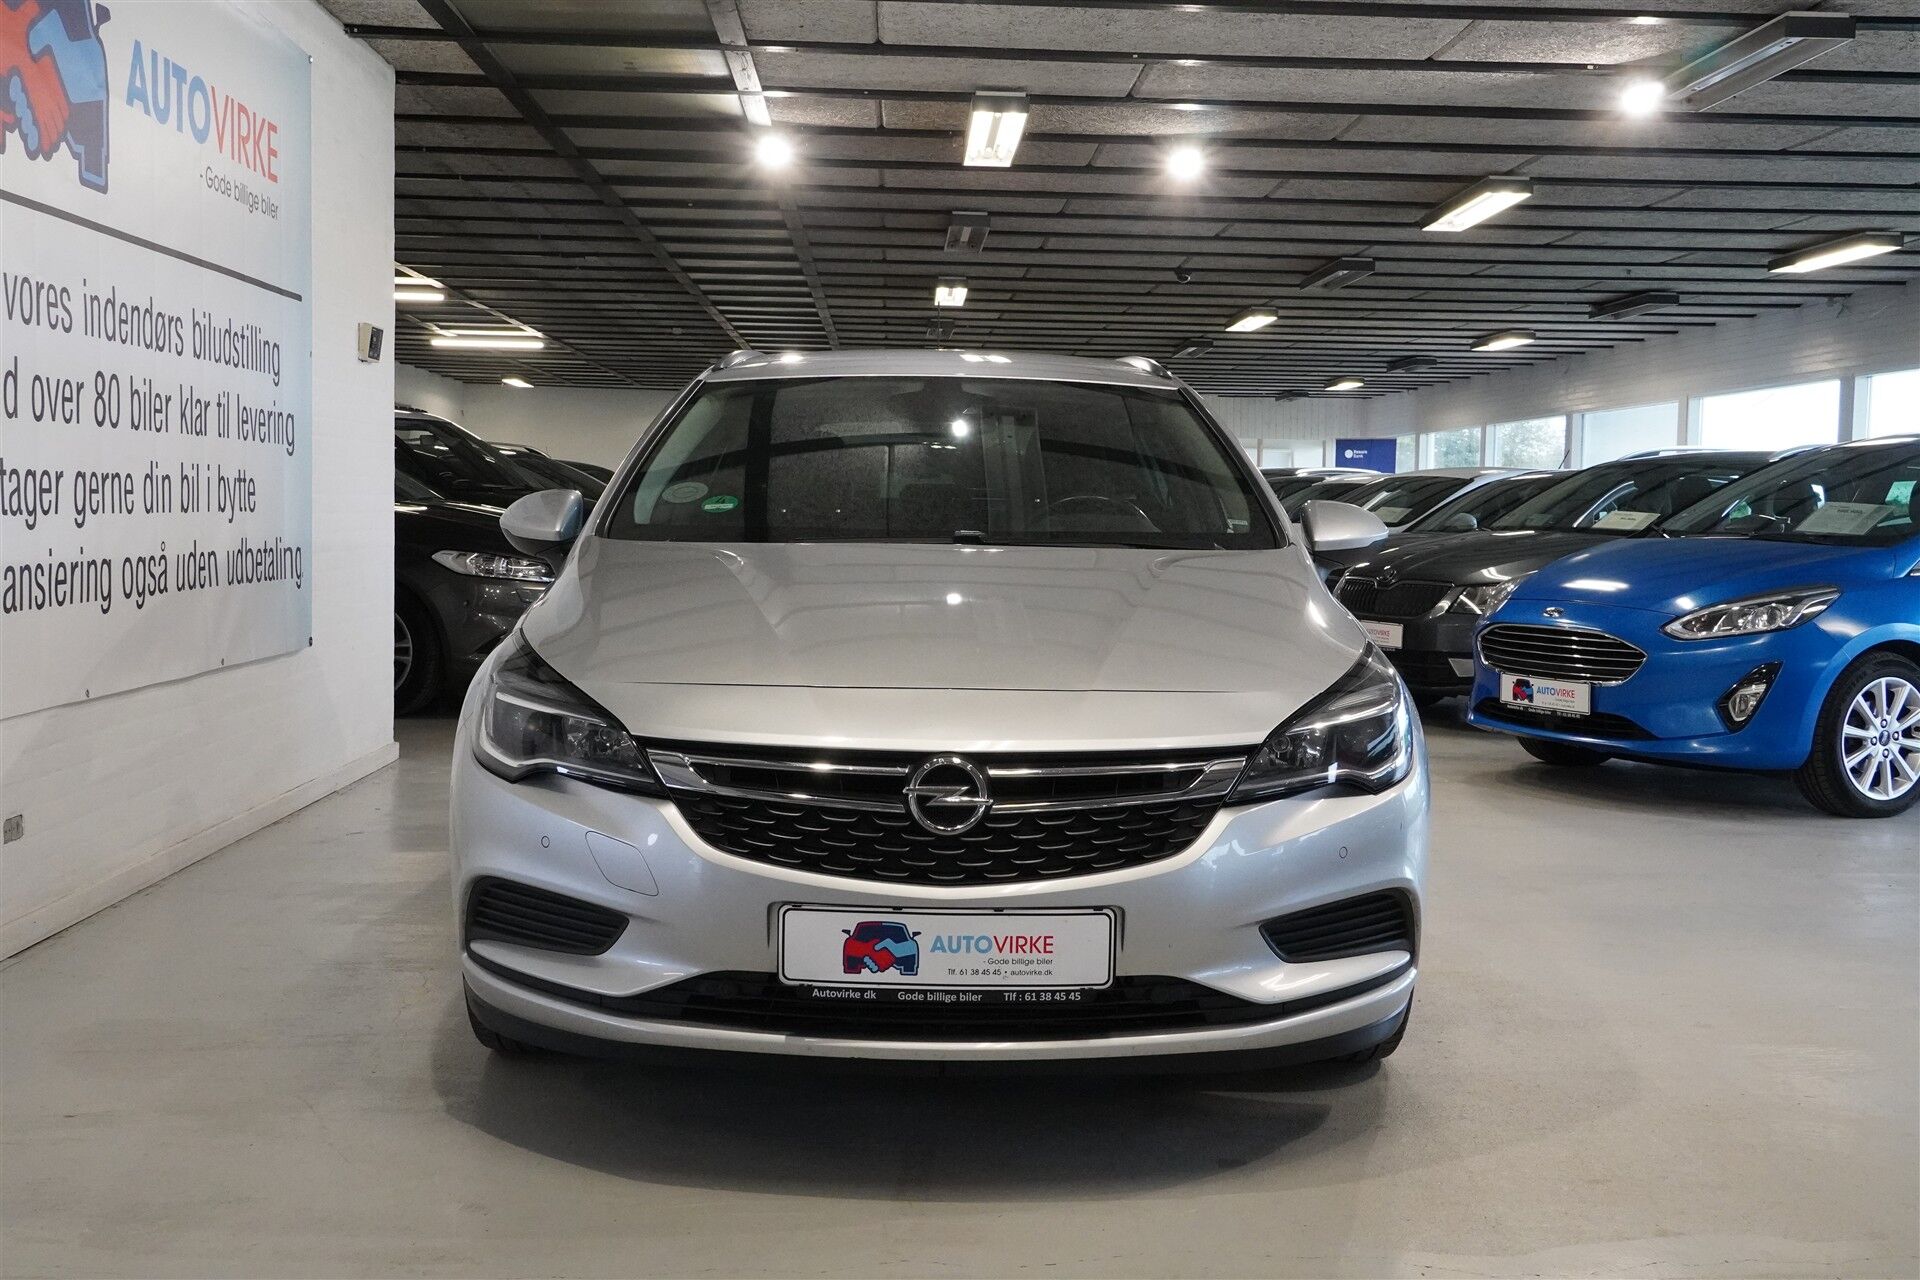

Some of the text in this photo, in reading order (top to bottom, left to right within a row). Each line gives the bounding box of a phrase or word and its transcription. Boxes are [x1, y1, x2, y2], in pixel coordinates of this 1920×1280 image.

[125, 39, 279, 184] AUTOVIRKE
[205, 166, 232, 198] Gode
[233, 179, 259, 214] billige
[261, 192, 279, 221] biler
[3, 272, 281, 387] vores indendørs biludstilling
[31, 374, 84, 425] over
[94, 370, 121, 429] 80
[130, 375, 172, 433] biler
[179, 384, 210, 438] klar
[217, 391, 231, 440] til
[236, 394, 295, 456] levering
[0, 457, 257, 531] tager gerne din bil i bytte
[122, 541, 169, 609] også
[176, 539, 219, 592] uden
[227, 536, 303, 589] udbetaling
[1536, 686, 1576, 699] AUTOVIRKE
[930, 935, 1054, 954] AUTOVIRKE
[948, 968, 1053, 976] Tlf. 61 38 45 45 autovirke.dk
[987, 957, 1010, 965] Gode
[1011, 957, 1035, 966] billige
[1036, 957, 1053, 965] biler
[812, 988, 861, 999] Autovirke
[863, 989, 877, 999] dk
[897, 991, 925, 1001] Gode
[927, 991, 957, 1002] billige
[959, 992, 982, 1001] biler
[1003, 992, 1017, 1001] Tlf
[1024, 992, 1037, 1001] 61
[1039, 992, 1051, 1001] 38
[1054, 992, 1066, 1001] 45
[1068, 991, 1081, 1001] 45
